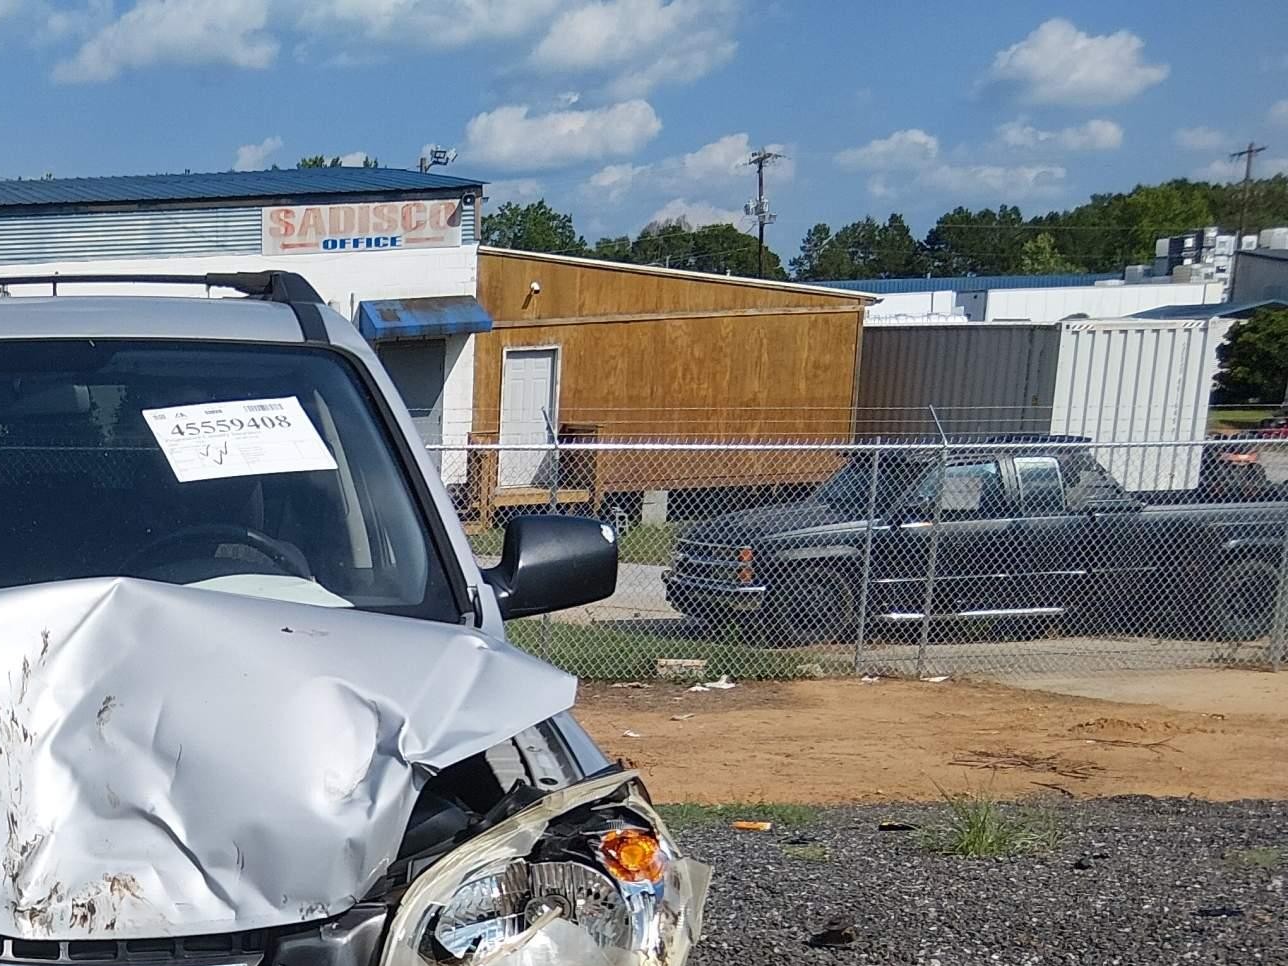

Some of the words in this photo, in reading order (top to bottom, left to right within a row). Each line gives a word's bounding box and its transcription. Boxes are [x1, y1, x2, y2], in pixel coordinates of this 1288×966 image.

[269, 202, 459, 239] SADISCO
[322, 235, 403, 251] OFFICE
[170, 415, 293, 437] 45559408
